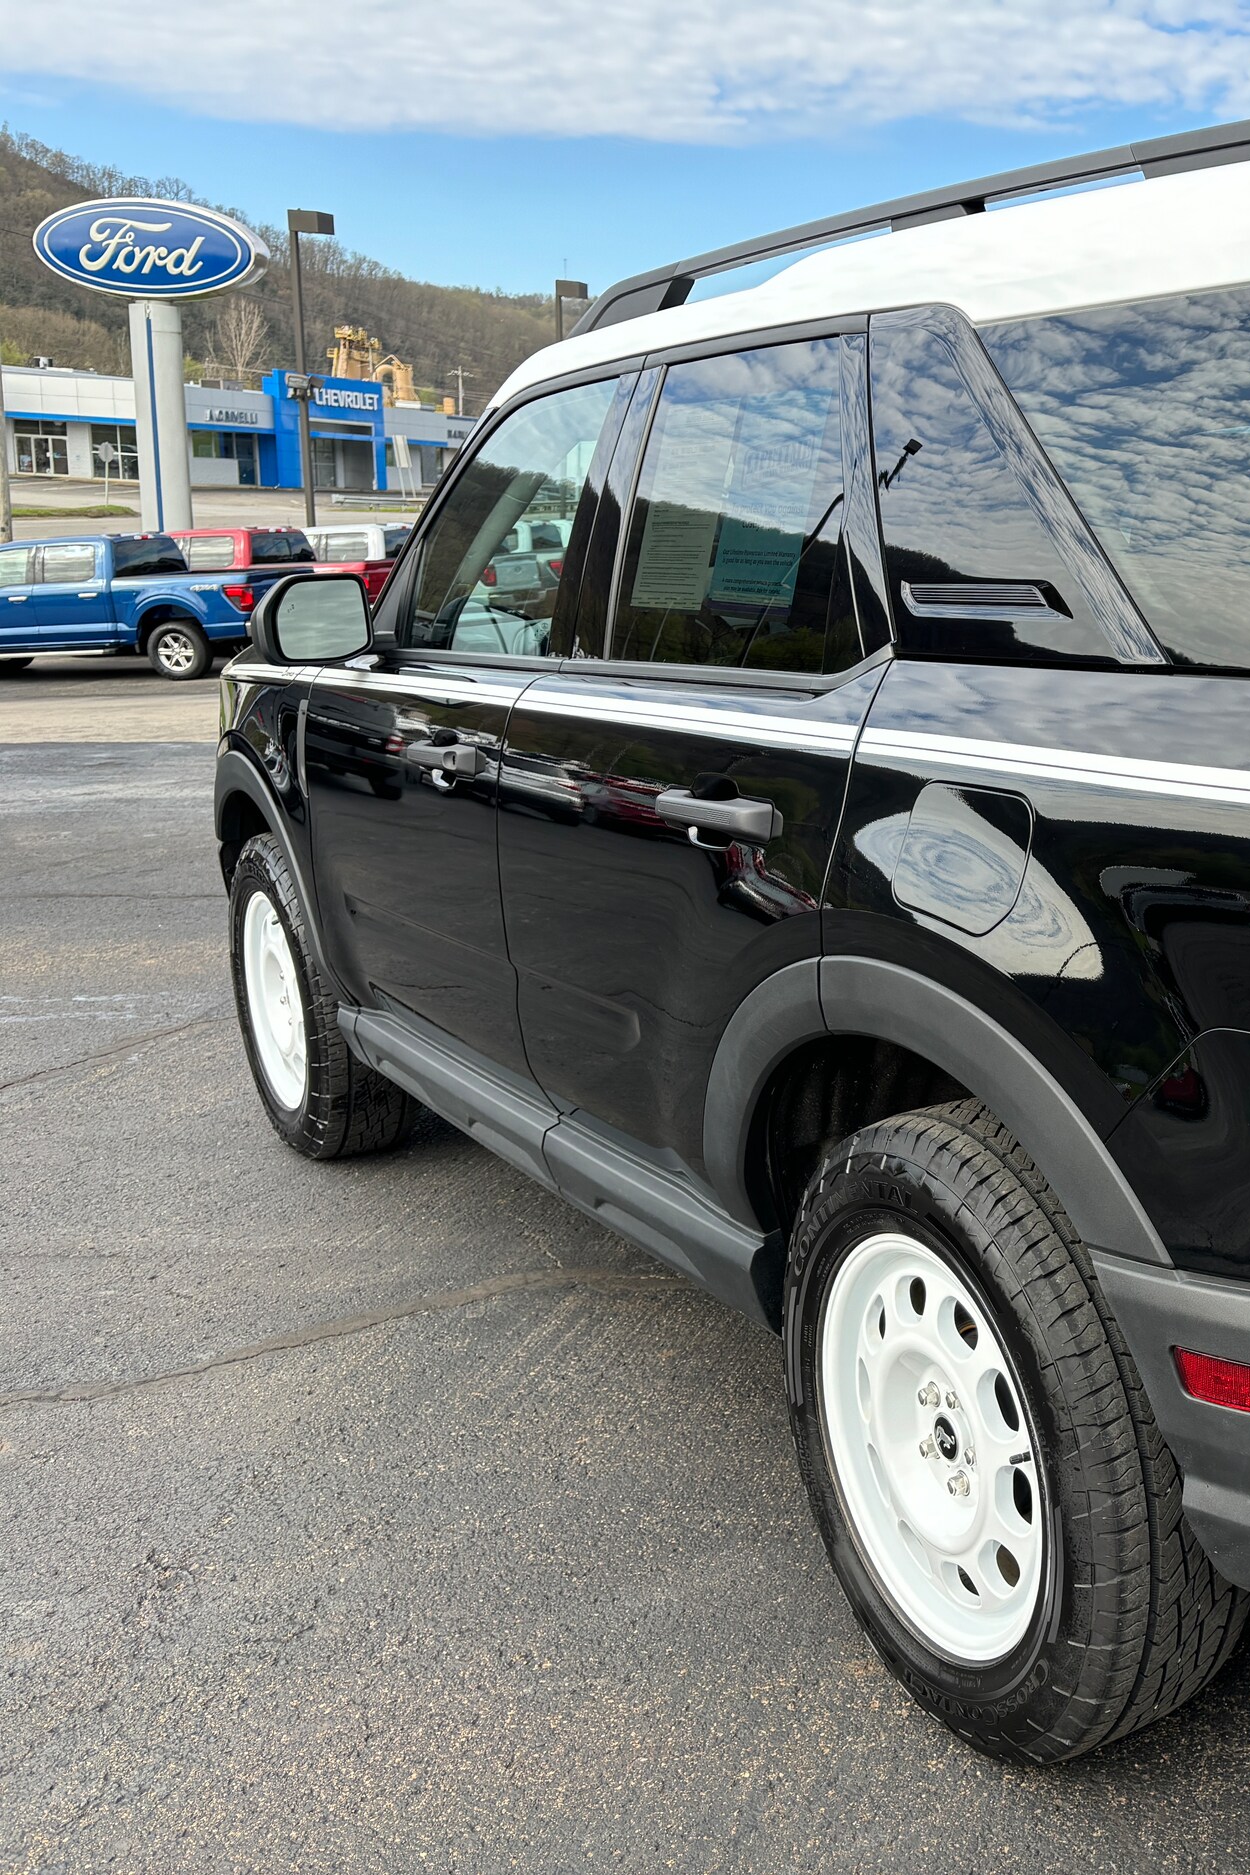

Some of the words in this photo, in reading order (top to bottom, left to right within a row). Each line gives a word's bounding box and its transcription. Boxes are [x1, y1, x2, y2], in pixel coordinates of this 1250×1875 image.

[79, 217, 206, 276] Ford
[312, 387, 379, 412] CHEVROLET
[794, 1179, 919, 1277] CONTINENTAL
